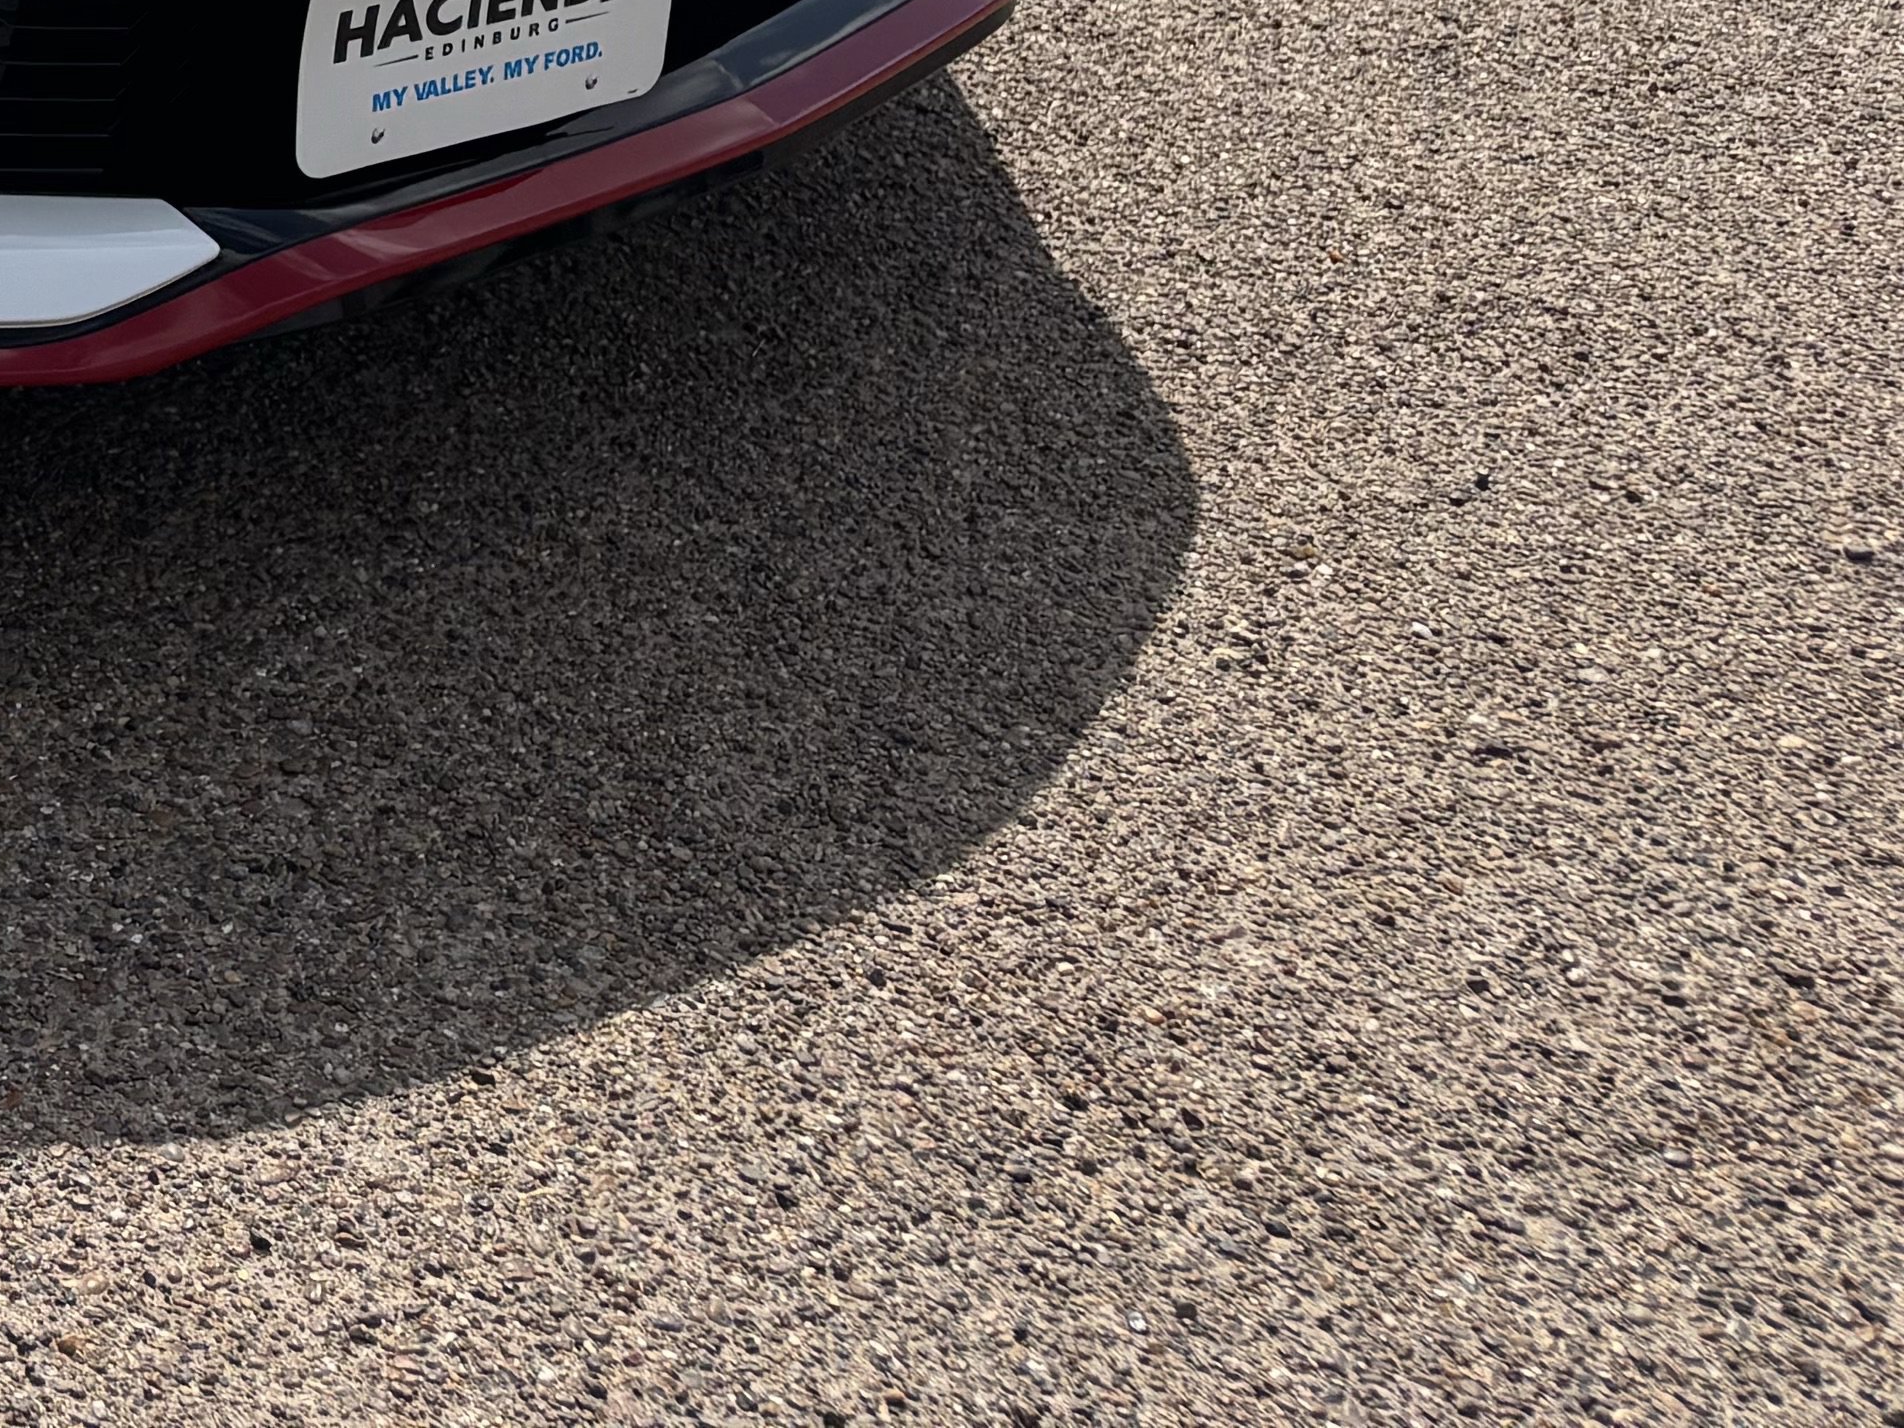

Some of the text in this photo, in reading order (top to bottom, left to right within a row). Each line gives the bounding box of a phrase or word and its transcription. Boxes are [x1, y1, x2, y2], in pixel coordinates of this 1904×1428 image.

[424, 17, 560, 61] EDINBURG
[371, 41, 603, 112] MY VALLEY. MY FORD.
